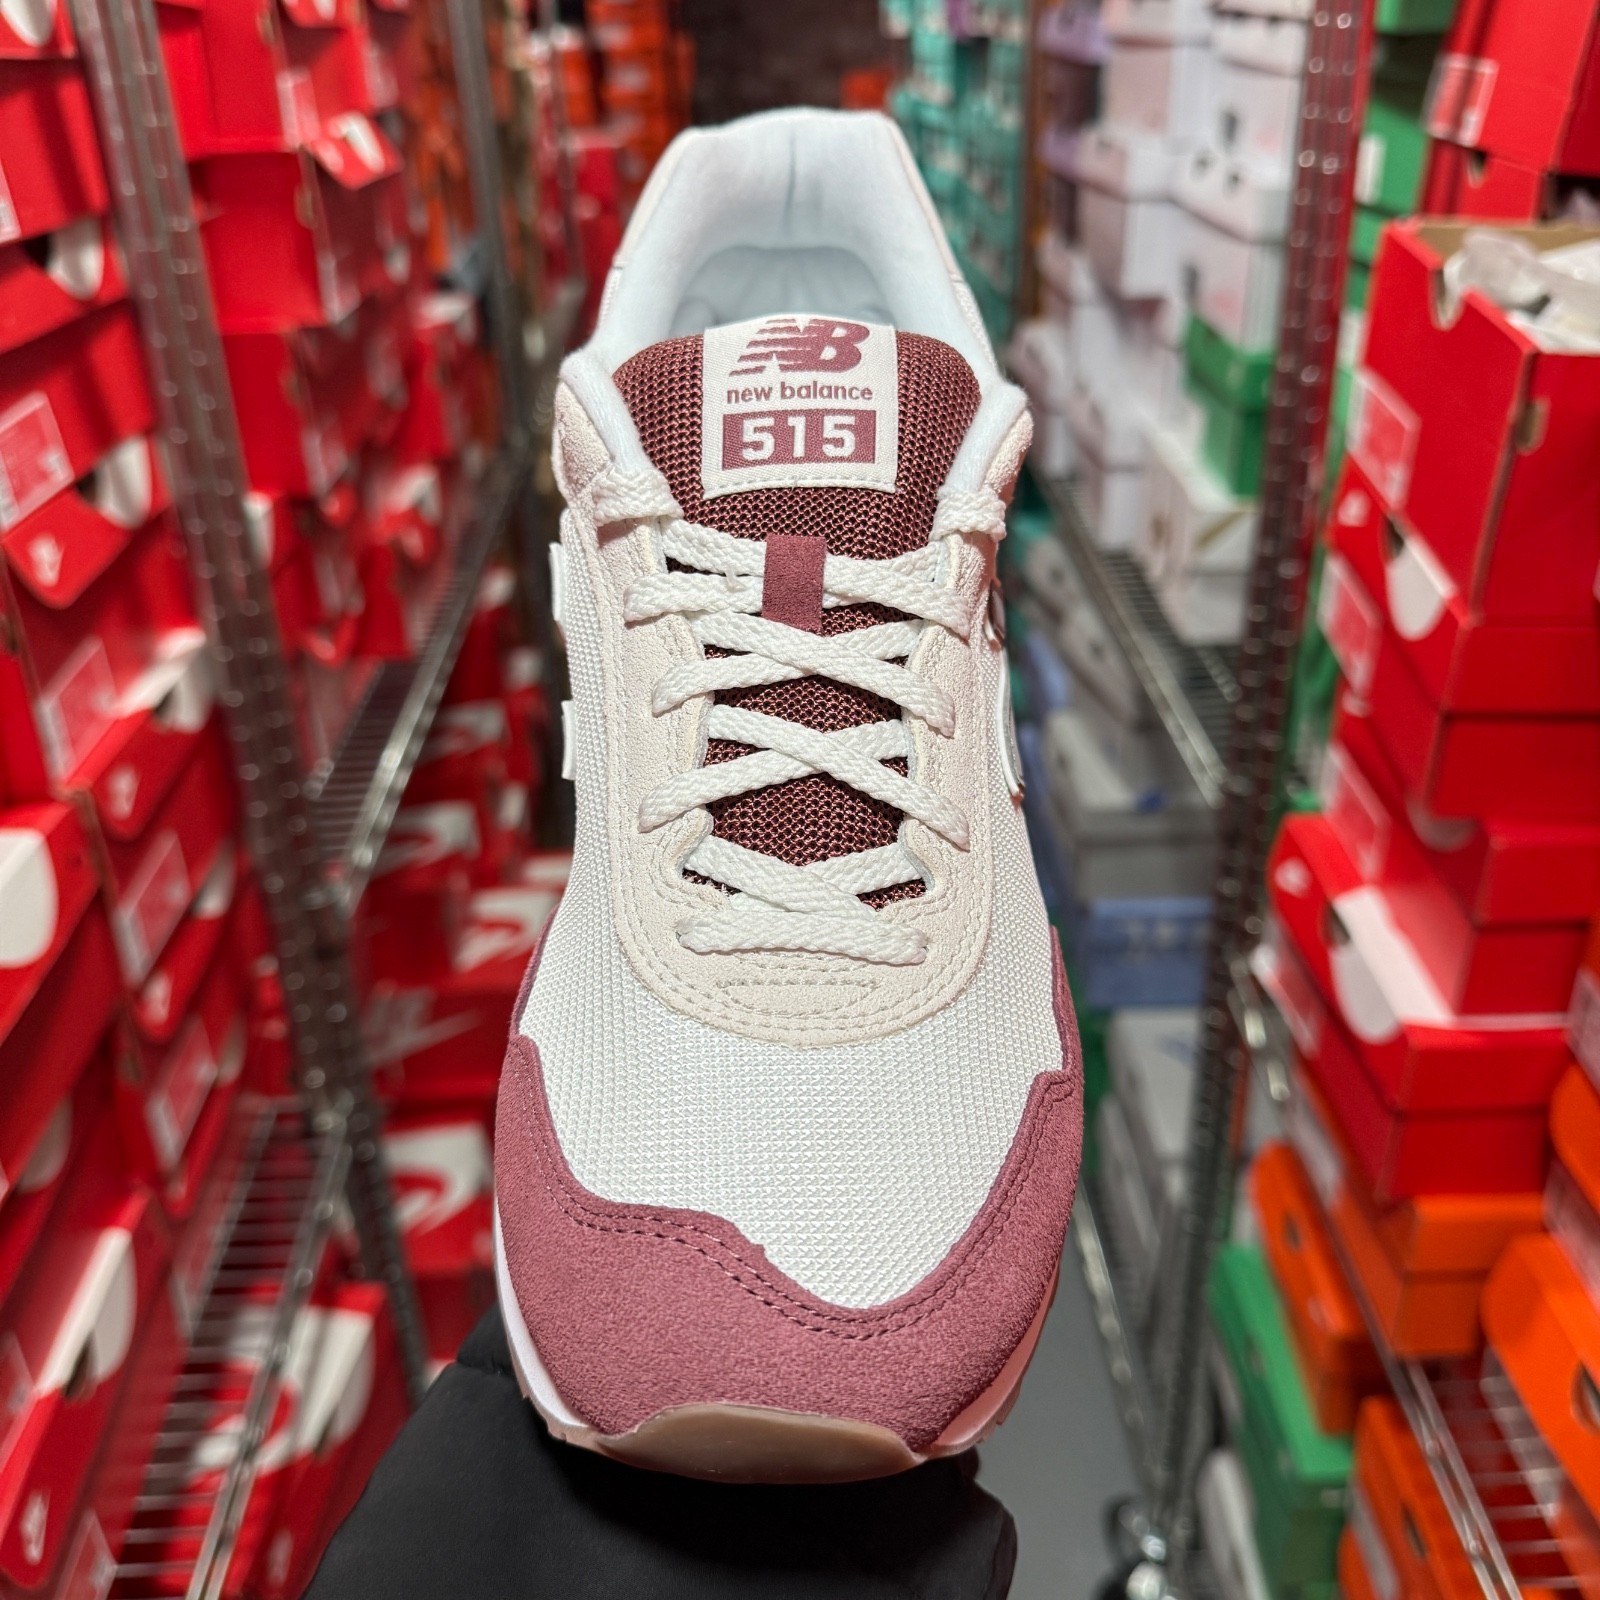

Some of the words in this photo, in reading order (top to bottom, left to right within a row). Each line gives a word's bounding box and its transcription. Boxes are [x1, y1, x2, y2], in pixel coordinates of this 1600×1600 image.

[727, 386, 773, 404] new
[780, 381, 873, 400] balance
[742, 415, 856, 461] 515
